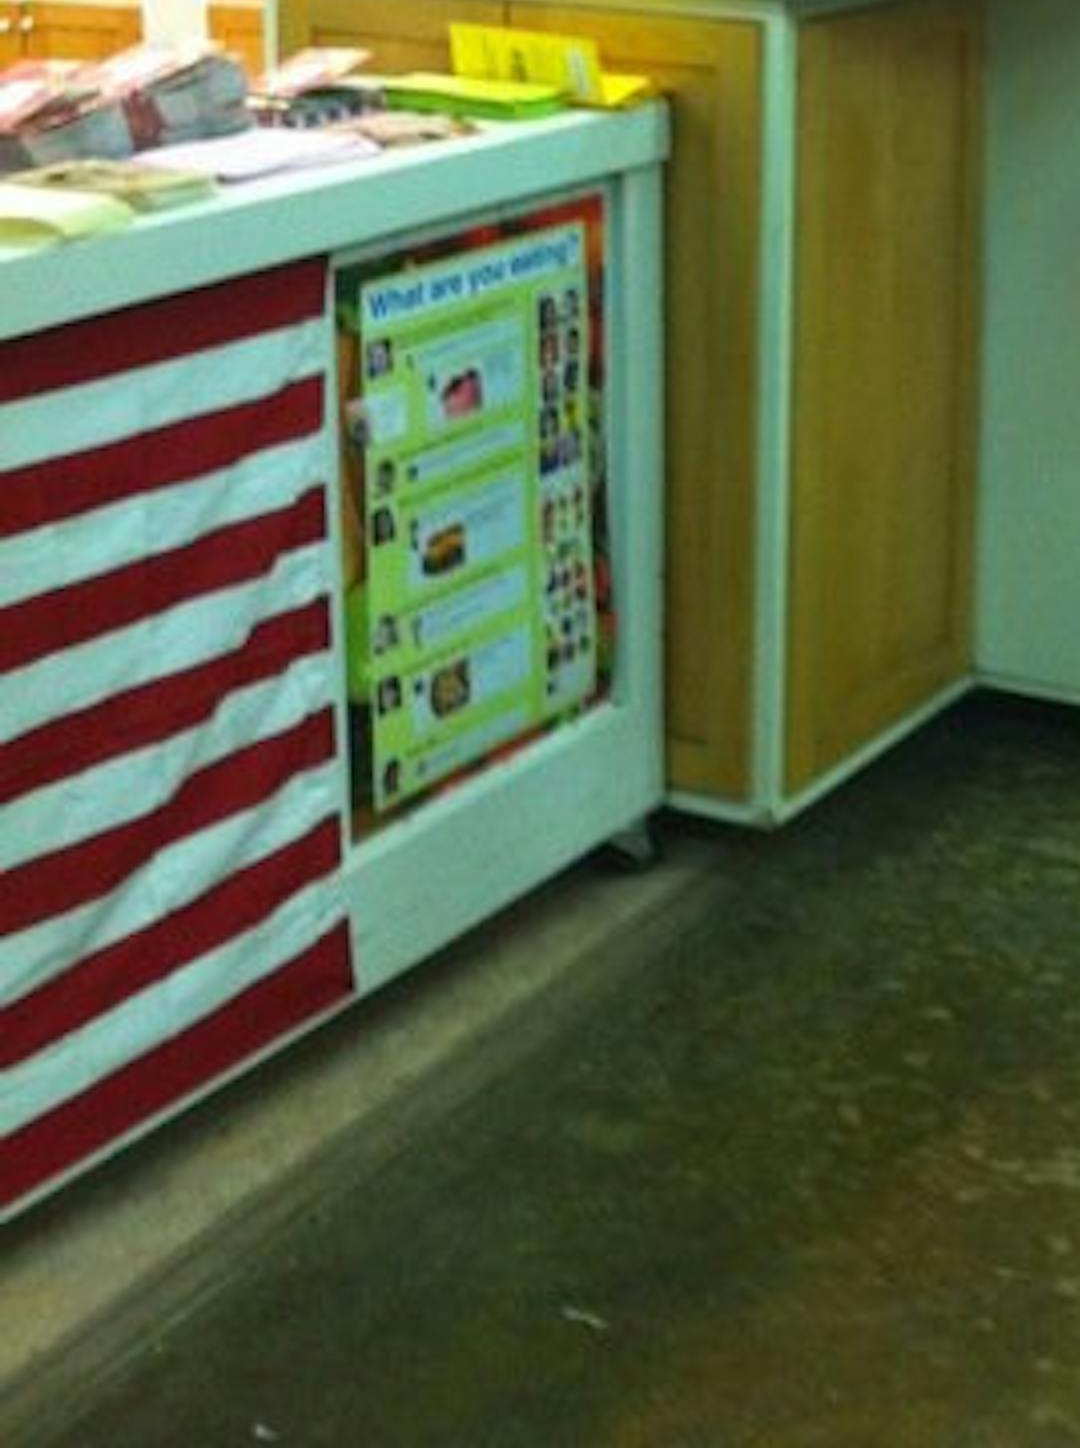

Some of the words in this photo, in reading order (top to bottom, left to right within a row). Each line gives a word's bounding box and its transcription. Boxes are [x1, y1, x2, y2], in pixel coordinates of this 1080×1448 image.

[368, 280, 425, 321] What
[430, 274, 464, 301] are
[468, 260, 506, 299] you
